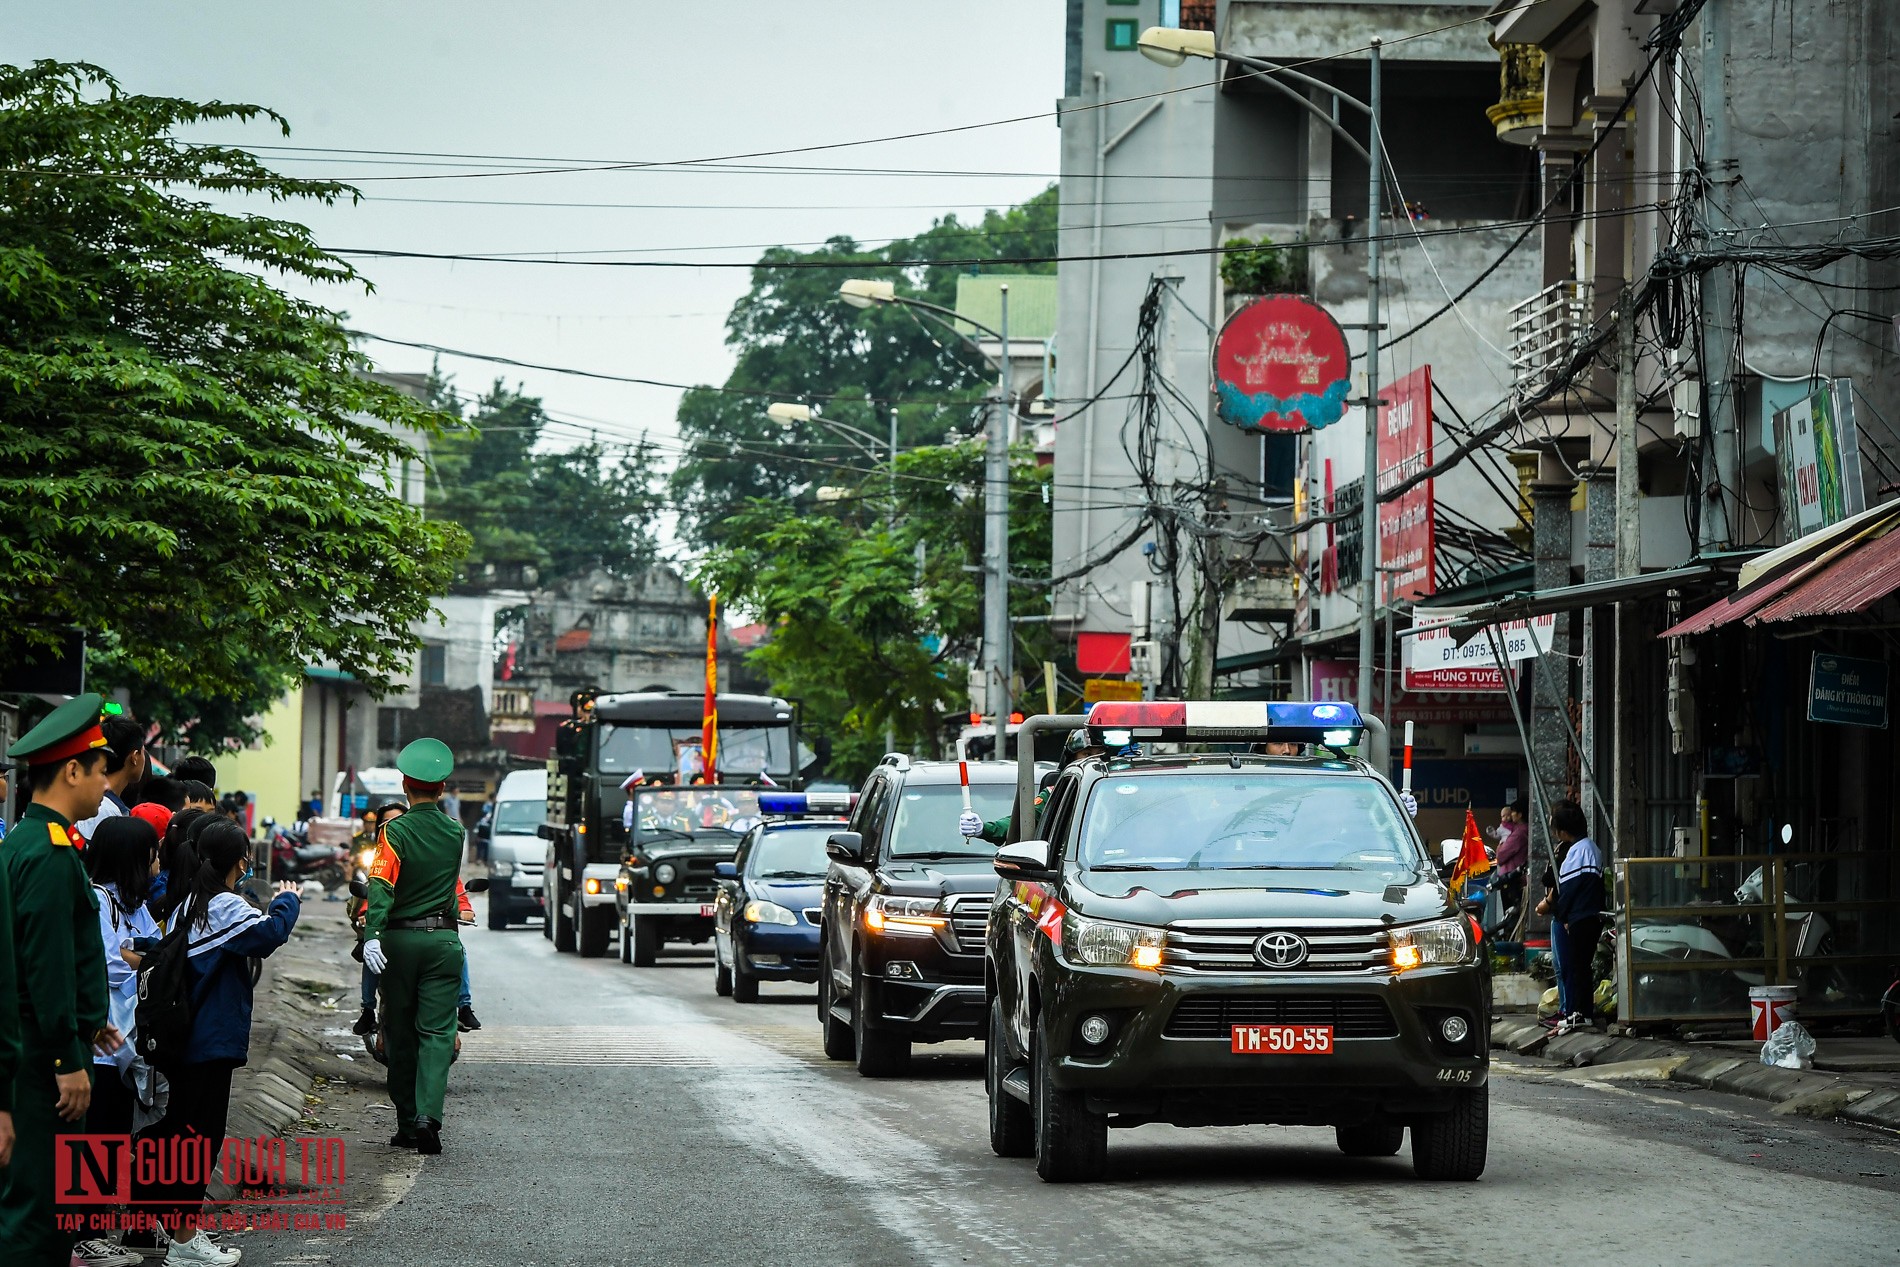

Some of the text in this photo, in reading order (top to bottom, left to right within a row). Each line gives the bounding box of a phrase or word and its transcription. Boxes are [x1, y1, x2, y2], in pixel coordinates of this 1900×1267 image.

[1433, 669, 1468, 682] HÙNG
[1433, 788, 1470, 804] UHD
[1235, 1027, 1329, 1051] TM-50-55
[1436, 1068, 1473, 1082] 44-05
